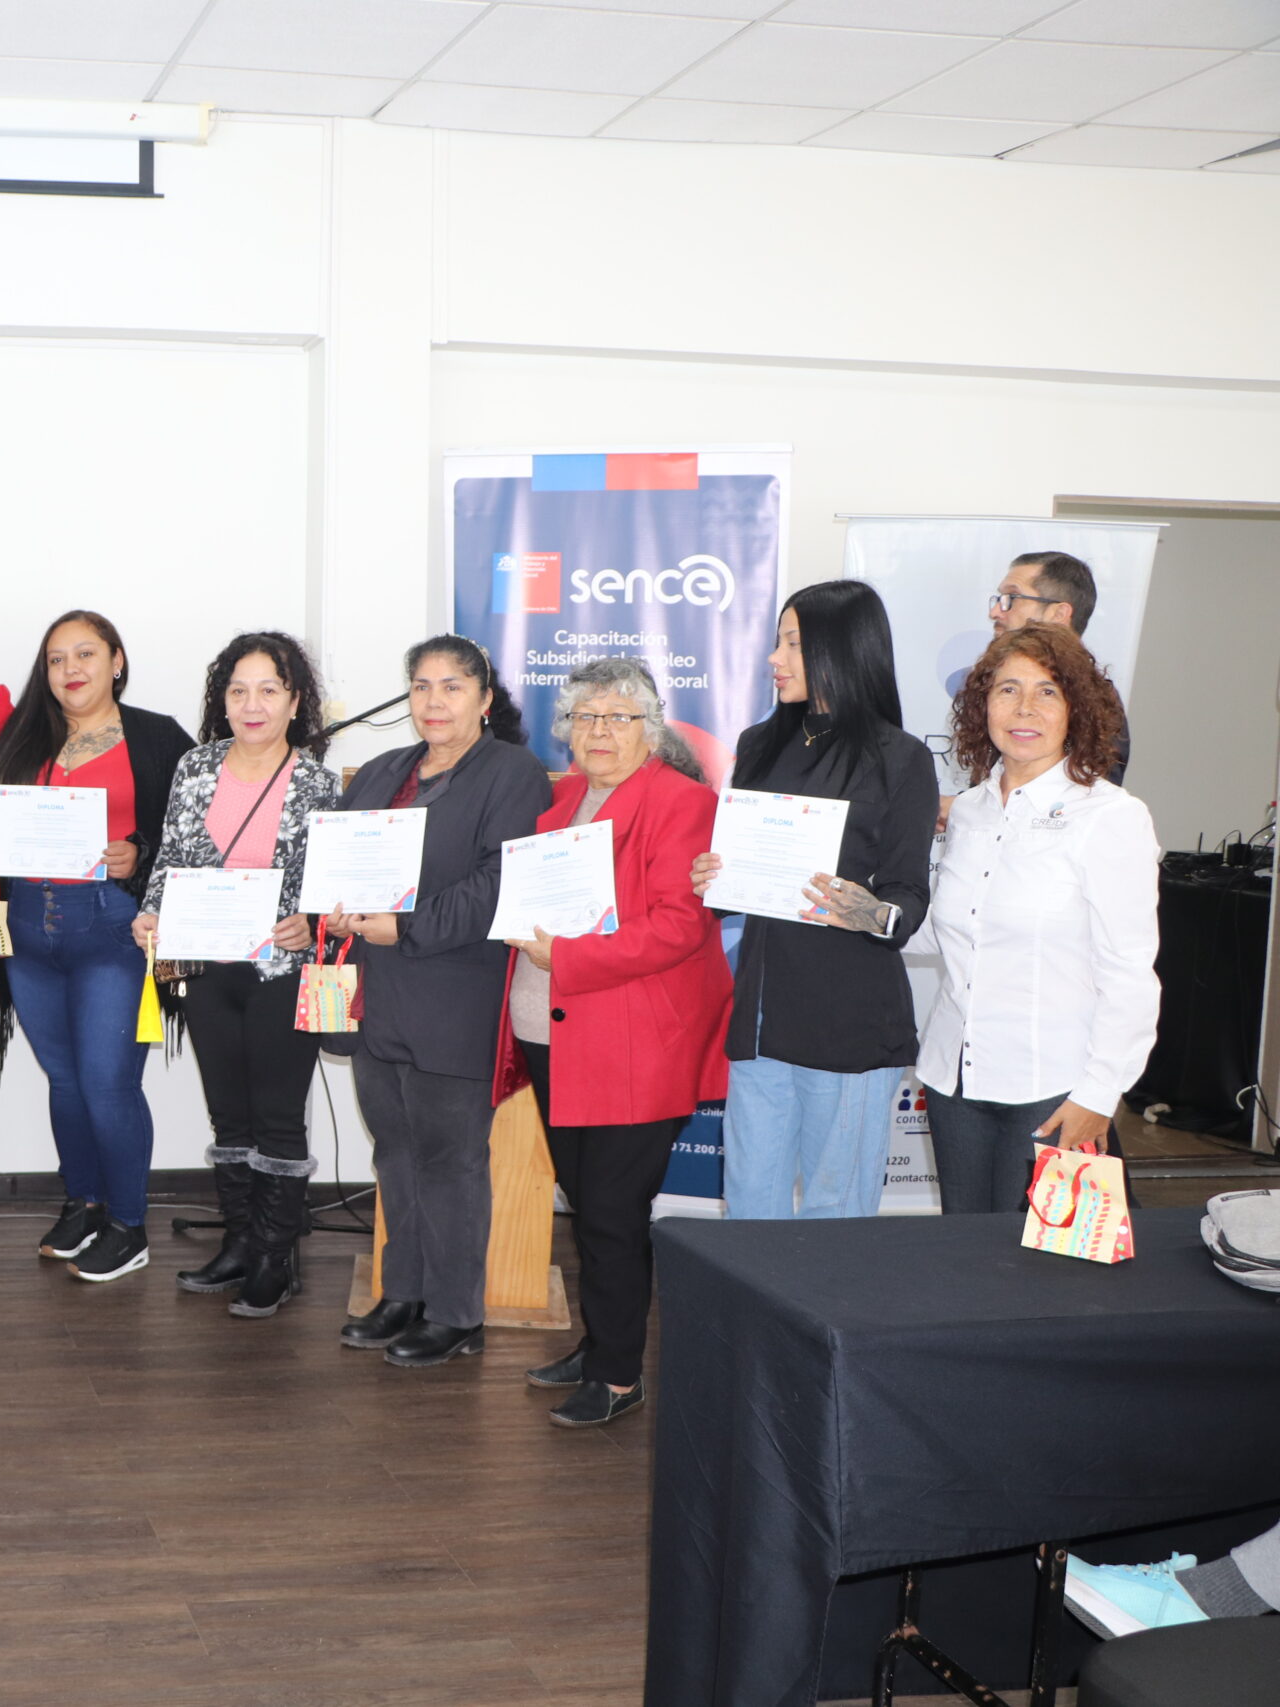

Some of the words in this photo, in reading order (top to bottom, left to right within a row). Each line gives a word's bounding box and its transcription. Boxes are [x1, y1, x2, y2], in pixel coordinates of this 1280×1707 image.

[554, 629, 668, 648] Capacitación
[763, 817, 794, 827] DIPLOMA
[542, 851, 569, 861] DIPLOMA
[678, 1142, 693, 1152] 71
[694, 1144, 716, 1154] 200
